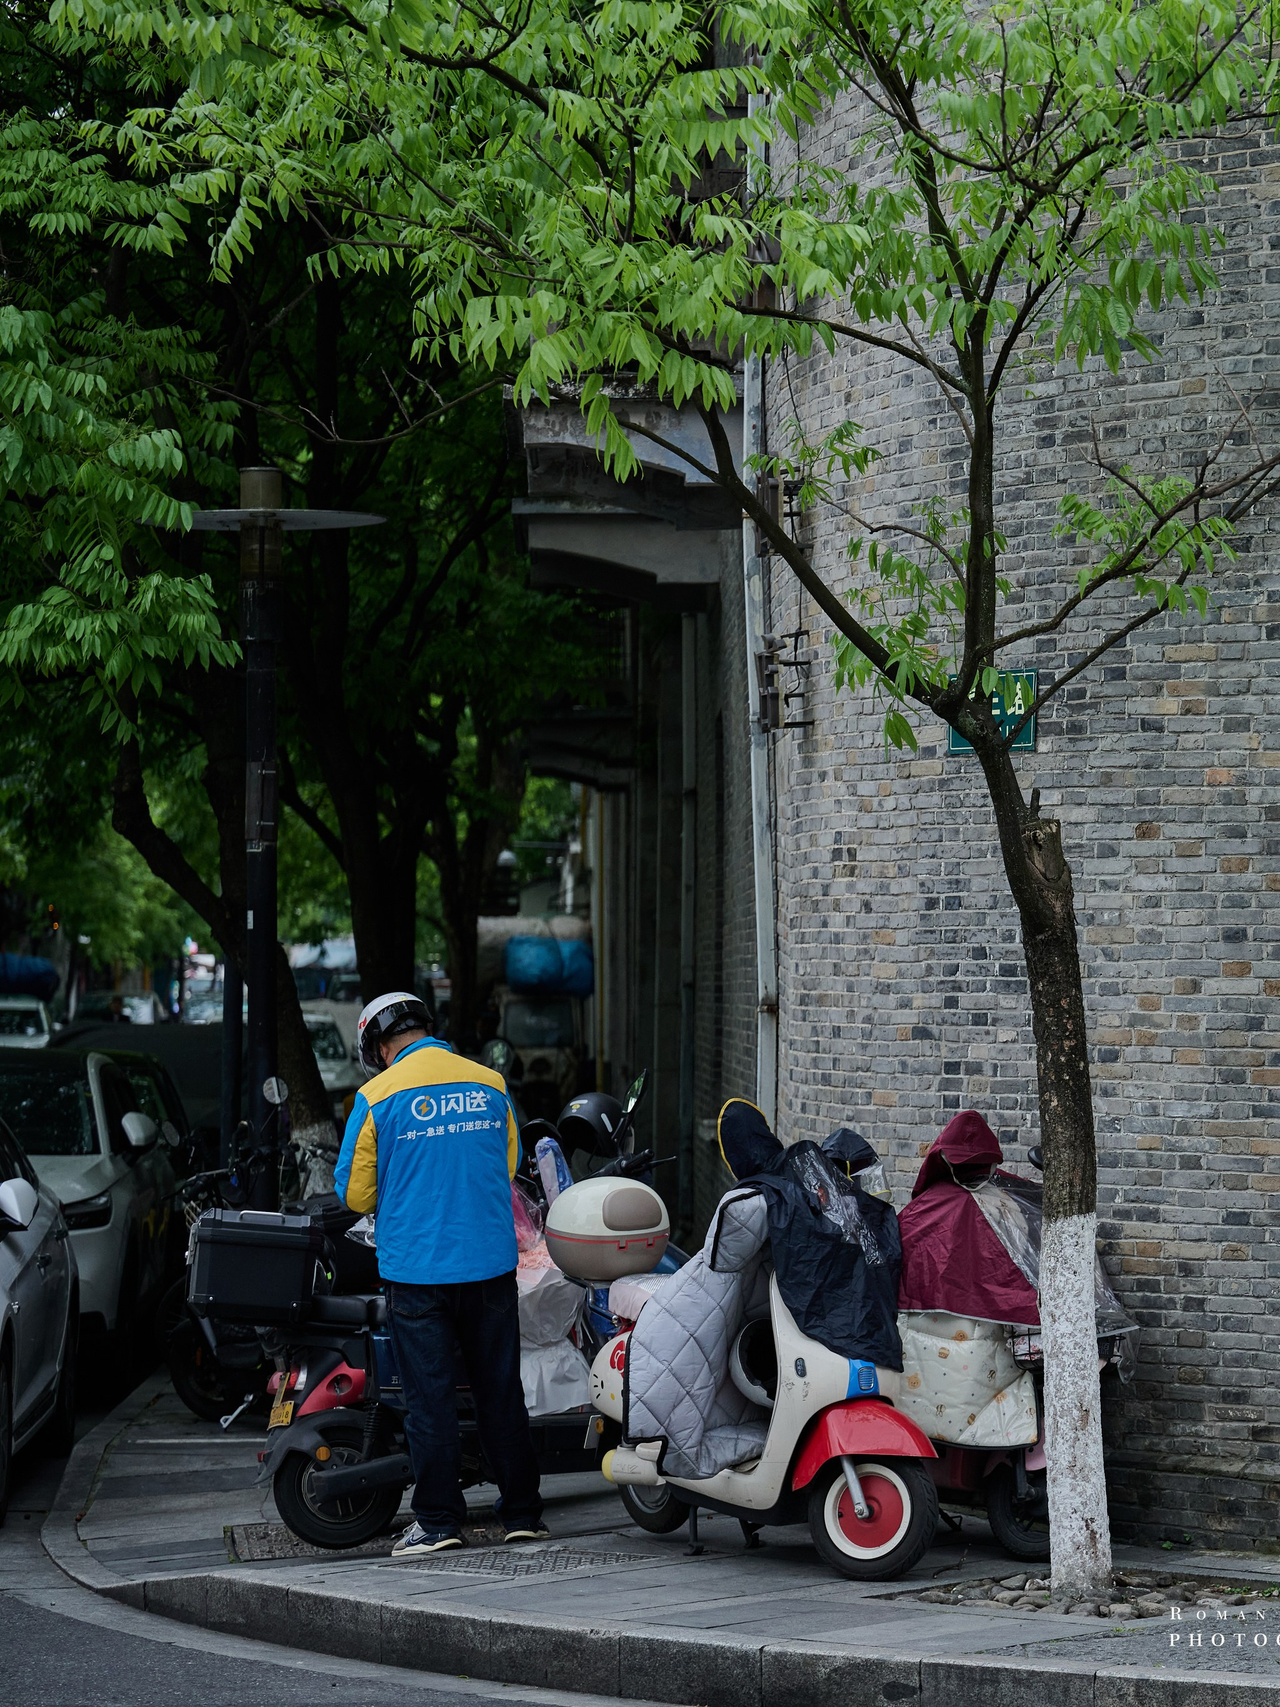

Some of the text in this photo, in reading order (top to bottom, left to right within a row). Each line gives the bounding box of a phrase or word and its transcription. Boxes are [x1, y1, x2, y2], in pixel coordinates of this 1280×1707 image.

[440, 1090, 487, 1116] 闪送
[397, 1125, 445, 1140] 一对一急送
